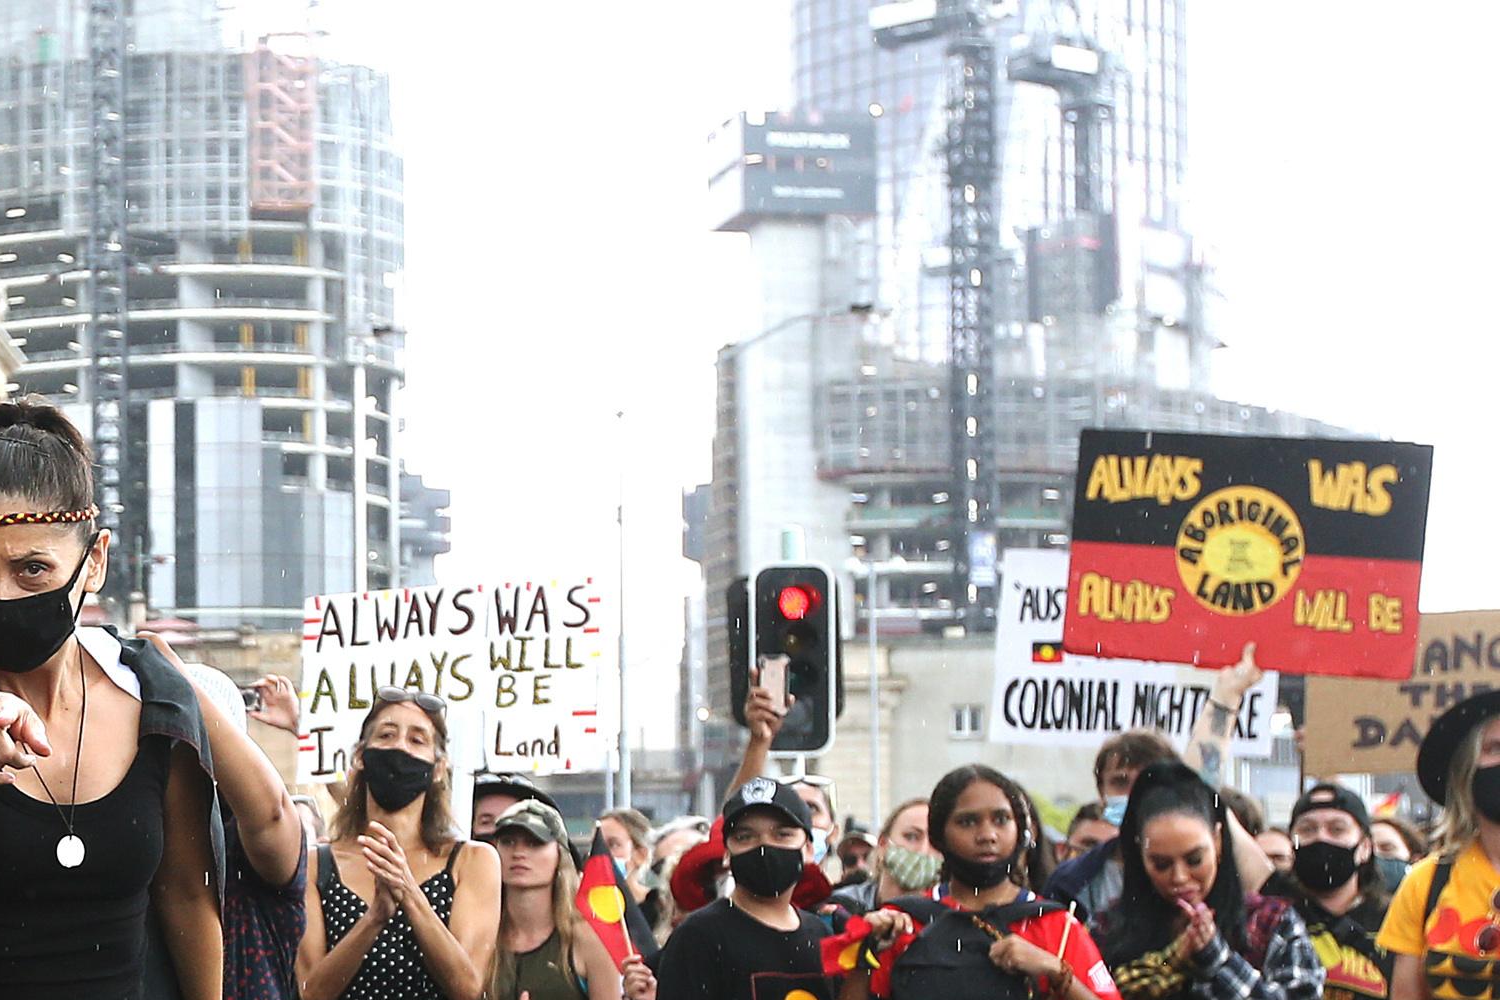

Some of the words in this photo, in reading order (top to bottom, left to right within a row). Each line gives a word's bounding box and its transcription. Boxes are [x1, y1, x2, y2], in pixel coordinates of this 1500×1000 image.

[1085, 453, 1204, 506] ALWAYS
[1307, 458, 1398, 517] WAS
[1179, 496, 1303, 577] ABORIGINAL
[316, 587, 475, 653] ALWAYS
[494, 585, 591, 635] WAS
[1077, 571, 1176, 624] ALWAYS
[1293, 589, 1354, 634] WILL
[1368, 591, 1403, 635] BE
[1196, 573, 1276, 612] LAND
[489, 636, 584, 673] WILL
[495, 673, 553, 708] BE
[1004, 678, 1121, 731] COLONIAL
[494, 721, 562, 759] Land
